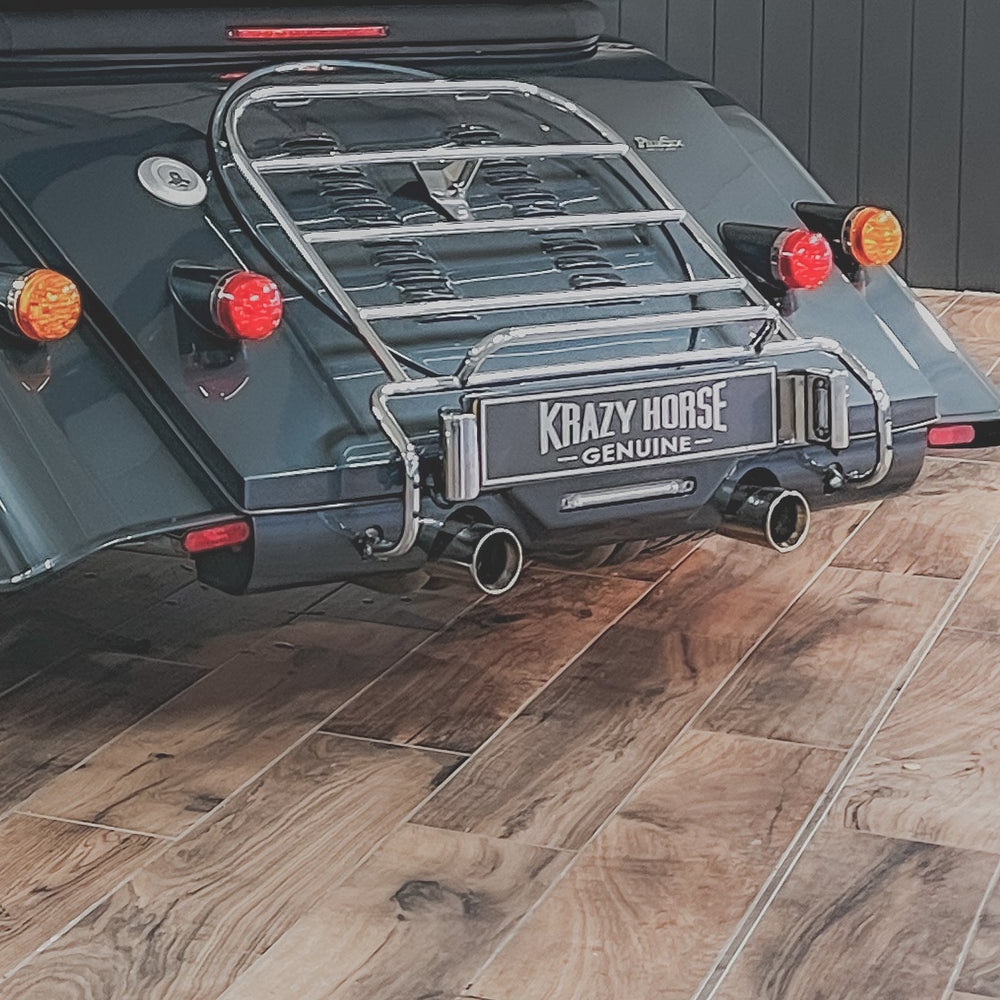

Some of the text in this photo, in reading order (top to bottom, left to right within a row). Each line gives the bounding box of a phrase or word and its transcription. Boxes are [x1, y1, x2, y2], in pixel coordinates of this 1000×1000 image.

[540, 381, 728, 455] KRAZY HORSE
[581, 436, 692, 465] GENUINE
